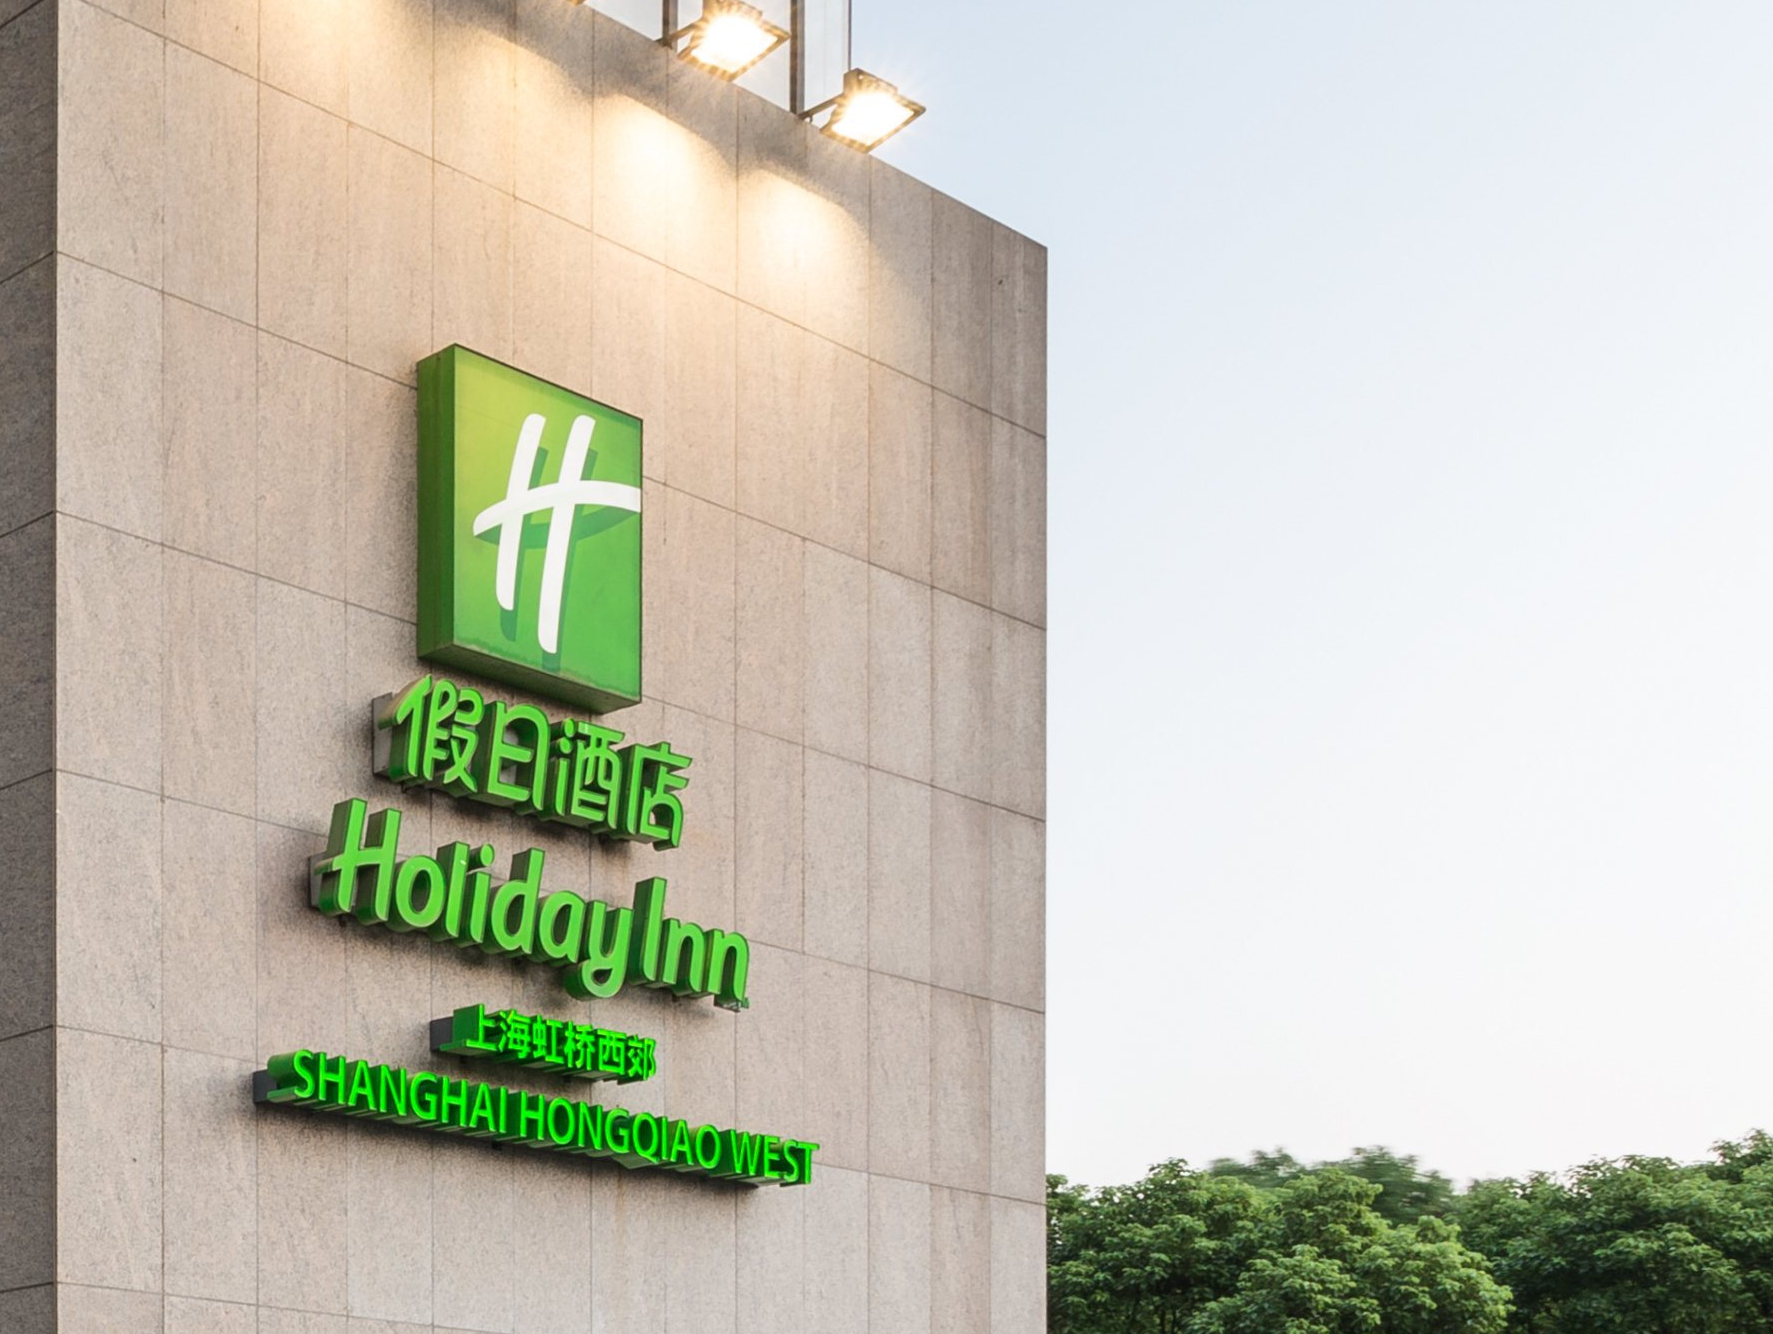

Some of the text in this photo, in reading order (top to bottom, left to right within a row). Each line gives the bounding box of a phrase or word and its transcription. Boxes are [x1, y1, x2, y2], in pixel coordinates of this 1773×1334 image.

[396, 674, 693, 849] 假日酒店
[330, 797, 750, 1004] Holiday Inn
[292, 1049, 820, 1184] SHANGHAI HONGQIAO WEST
[466, 1003, 657, 1081] 上海虹桥西郊
